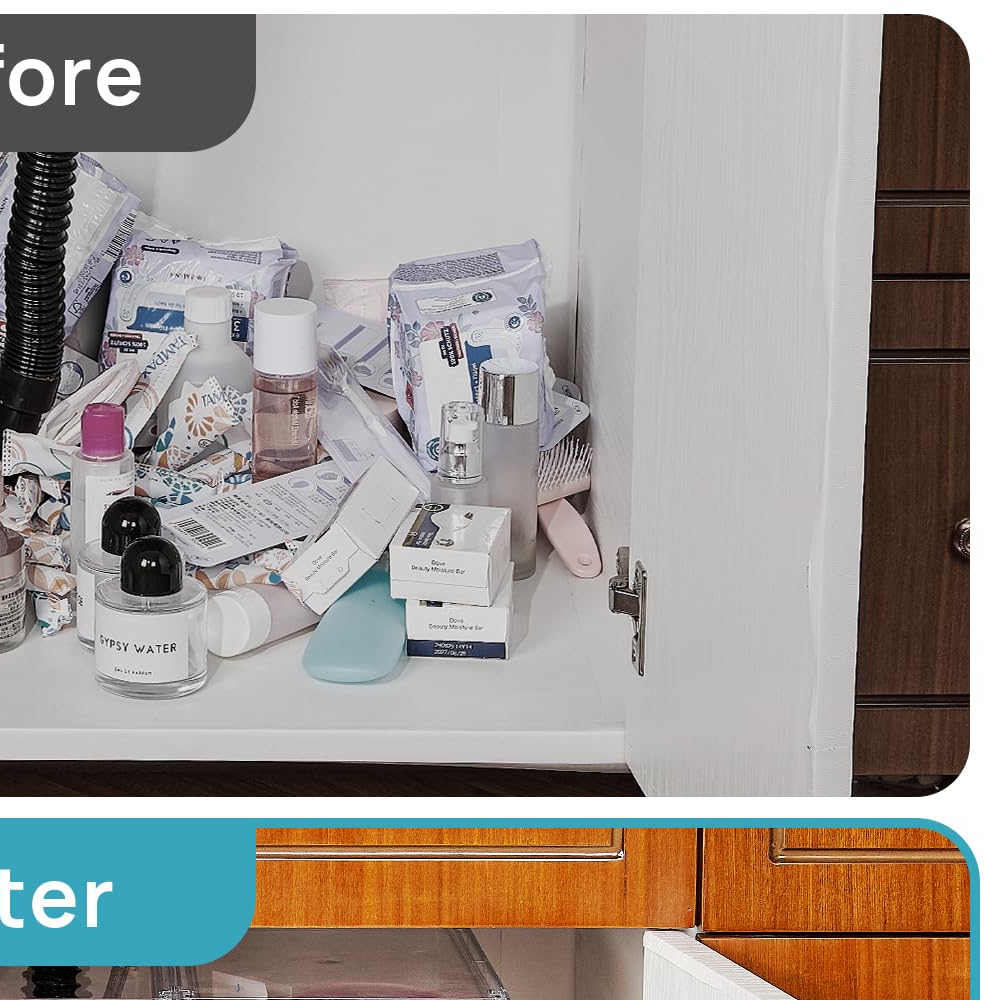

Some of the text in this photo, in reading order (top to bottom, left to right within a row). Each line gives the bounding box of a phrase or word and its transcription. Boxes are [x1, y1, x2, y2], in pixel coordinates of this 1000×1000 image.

[142, 335, 187, 379] TAMPAX
[411, 565, 430, 574] Beauty
[431, 566, 455, 574] Moisture
[431, 559, 446, 567] Dove
[99, 634, 177, 654] GYPSY WATER
